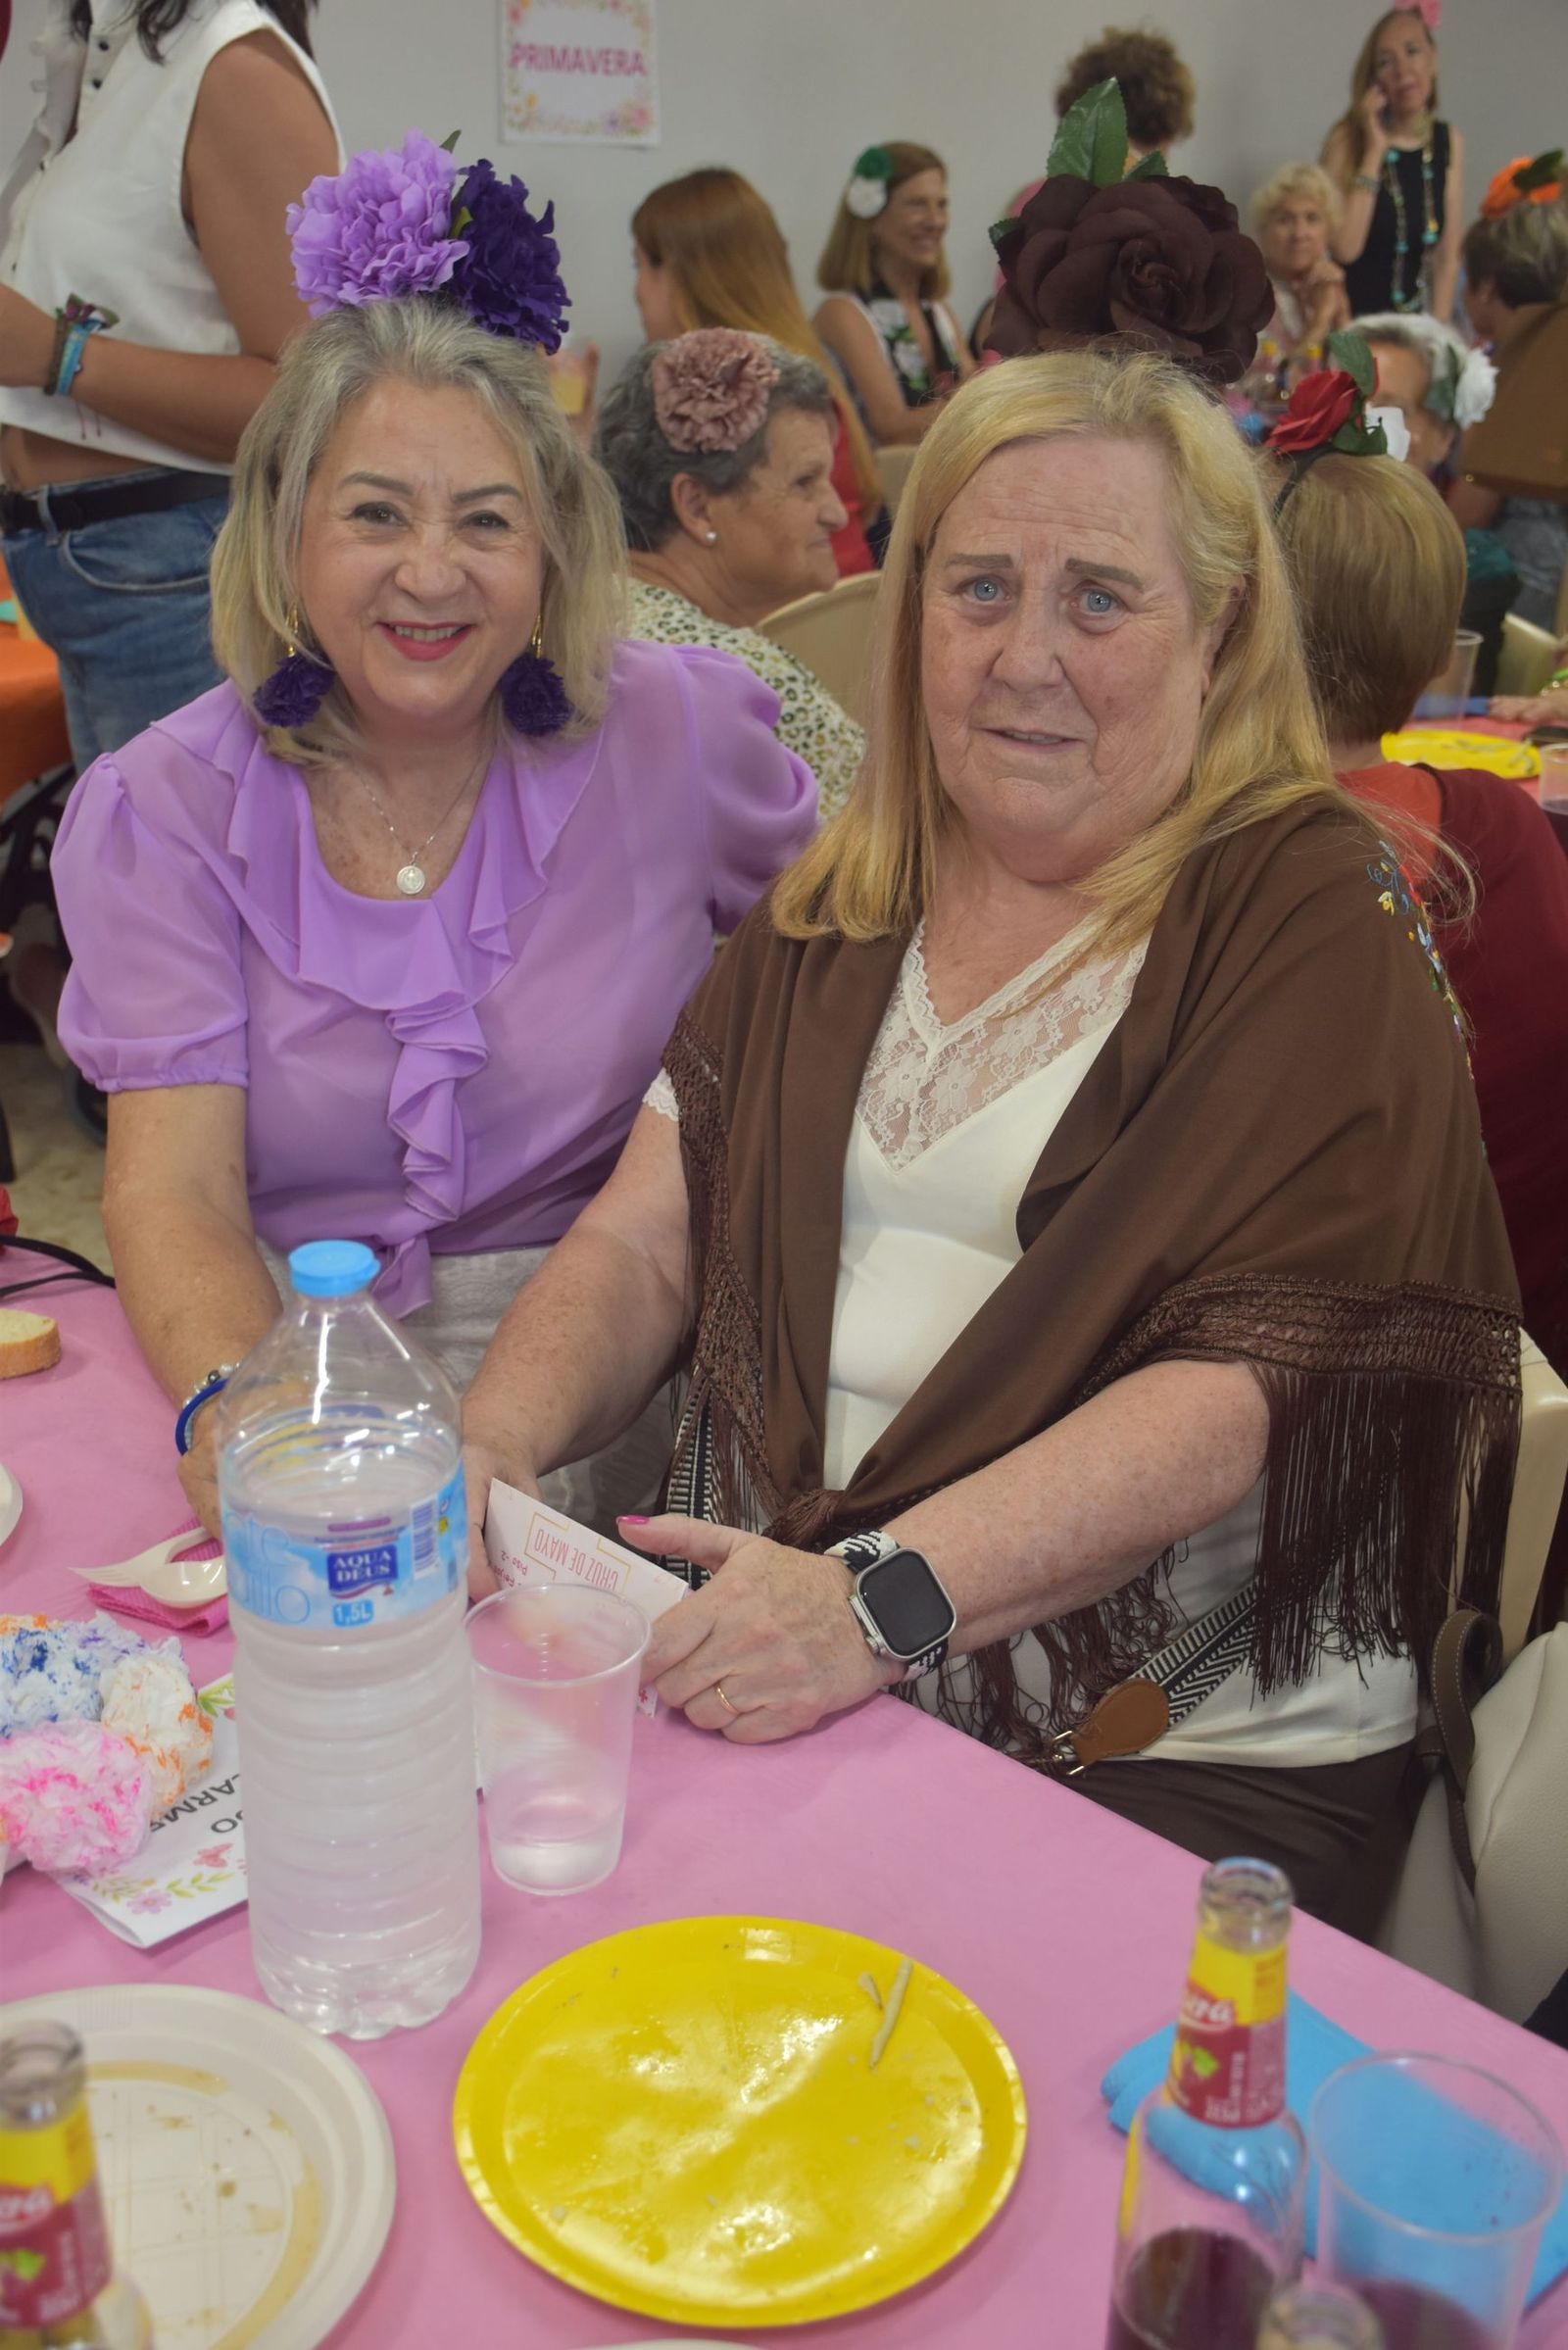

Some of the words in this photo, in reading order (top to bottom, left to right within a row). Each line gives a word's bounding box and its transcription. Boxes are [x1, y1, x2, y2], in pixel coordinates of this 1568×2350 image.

[508, 42, 648, 76] PRIMAVERA
[333, 1549, 392, 1571] AQUA
[535, 1529, 569, 1567] MAYO
[335, 1564, 390, 1584] DEUS
[568, 1547, 586, 1577] DE
[585, 1558, 618, 1591] CRUZ
[335, 1605, 372, 1625] 1,5L
[211, 1809, 243, 1834] O
